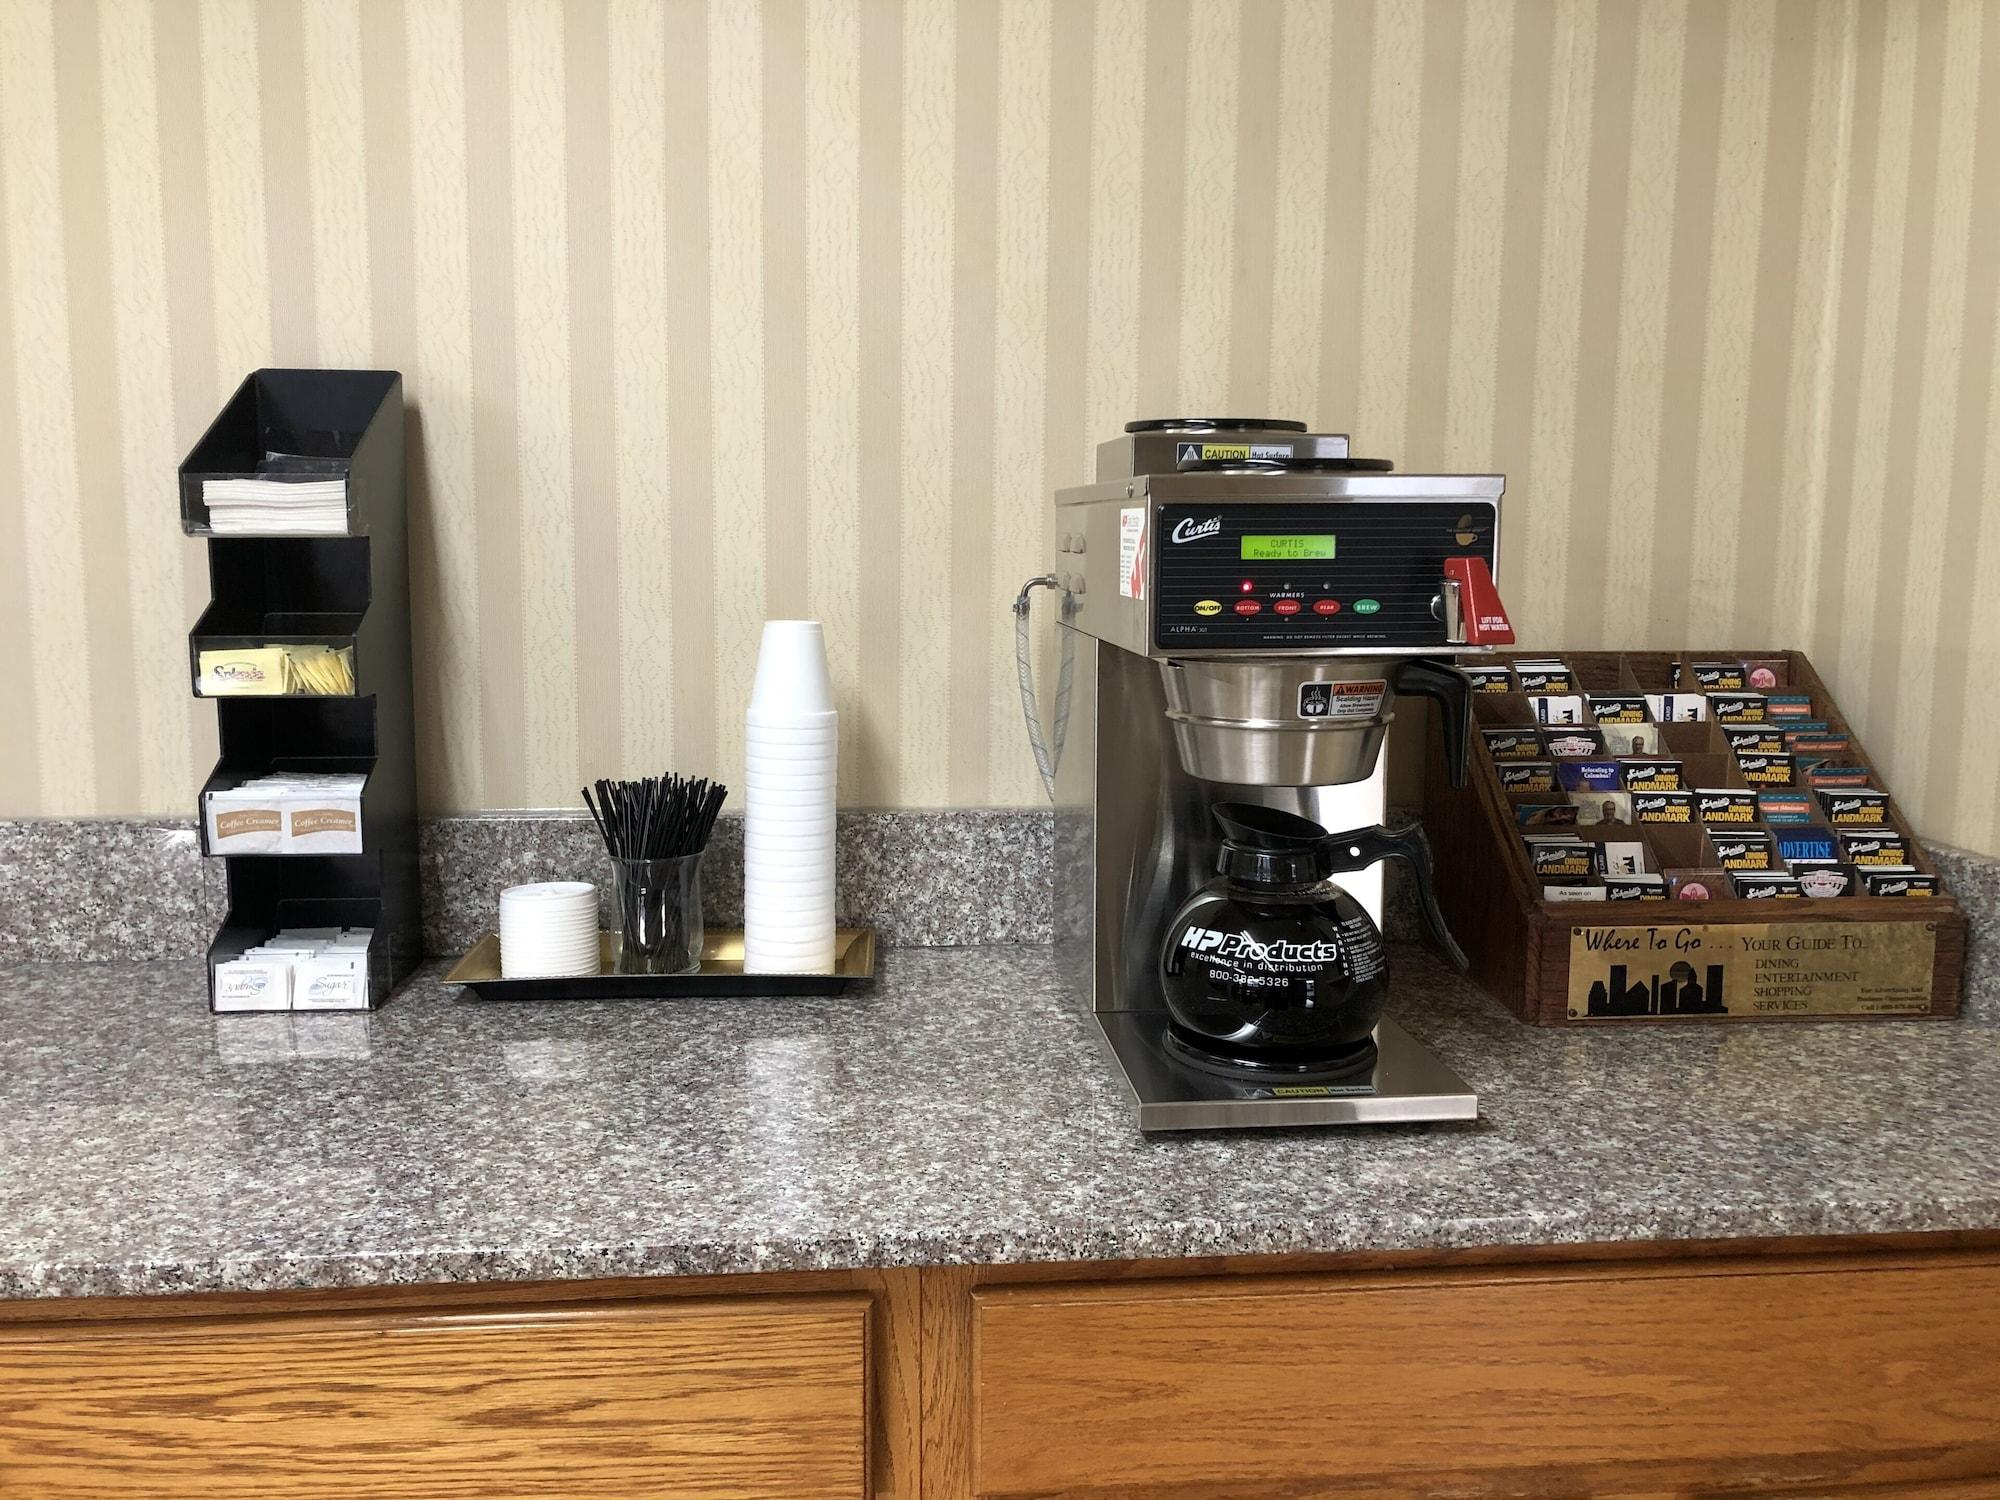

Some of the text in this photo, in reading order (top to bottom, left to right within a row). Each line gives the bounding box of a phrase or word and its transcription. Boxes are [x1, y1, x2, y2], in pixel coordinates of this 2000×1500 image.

[1204, 450, 1246, 459] CAUTION
[1171, 516, 1220, 544] Curtis
[1270, 539, 1304, 548] CURTIS
[1254, 550, 1326, 559] Ready to Brew
[1545, 682, 1568, 690] DINING
[1718, 678, 1741, 686] DINING
[1344, 684, 1383, 694] WARNING
[1620, 710, 1644, 719] DINING
[1742, 708, 1764, 716] DINING
[1515, 743, 1539, 752] DINING
[1765, 766, 1791, 774] DINING
[1654, 774, 1679, 782] DINING
[1743, 772, 1790, 783] ANDMARK
[1503, 784, 1552, 793] LANDMARK
[1627, 781, 1678, 791] LANDMARK
[1664, 805, 1690, 813] DINING
[1728, 805, 1754, 813] DINING
[1859, 806, 1884, 814] DINING
[294, 816, 352, 829] Coffee Creamer
[1832, 813, 1883, 823] LANDMARK
[220, 817, 280, 829] Coffee Creamer
[1744, 851, 1768, 860] DINING
[1878, 849, 1904, 857] DINING
[1564, 857, 1589, 865] DINING
[1724, 859, 1769, 869] ANDMARK
[1536, 864, 1589, 874] LANDMARK
[1906, 888, 1932, 896] DINING
[1585, 928, 1640, 952] Where
[1647, 928, 1667, 950] To
[1675, 928, 1701, 953] Go
[1217, 931, 1337, 962] Products
[1190, 952, 1323, 973] excellence in distribution
[1755, 959, 1799, 969] DINING
[1755, 971, 1860, 983] ENTERTAINMENT
[316, 976, 348, 993] Sugar
[1754, 986, 1812, 997] SHOPPING
[1753, 1000, 1808, 1011] SERVICES
